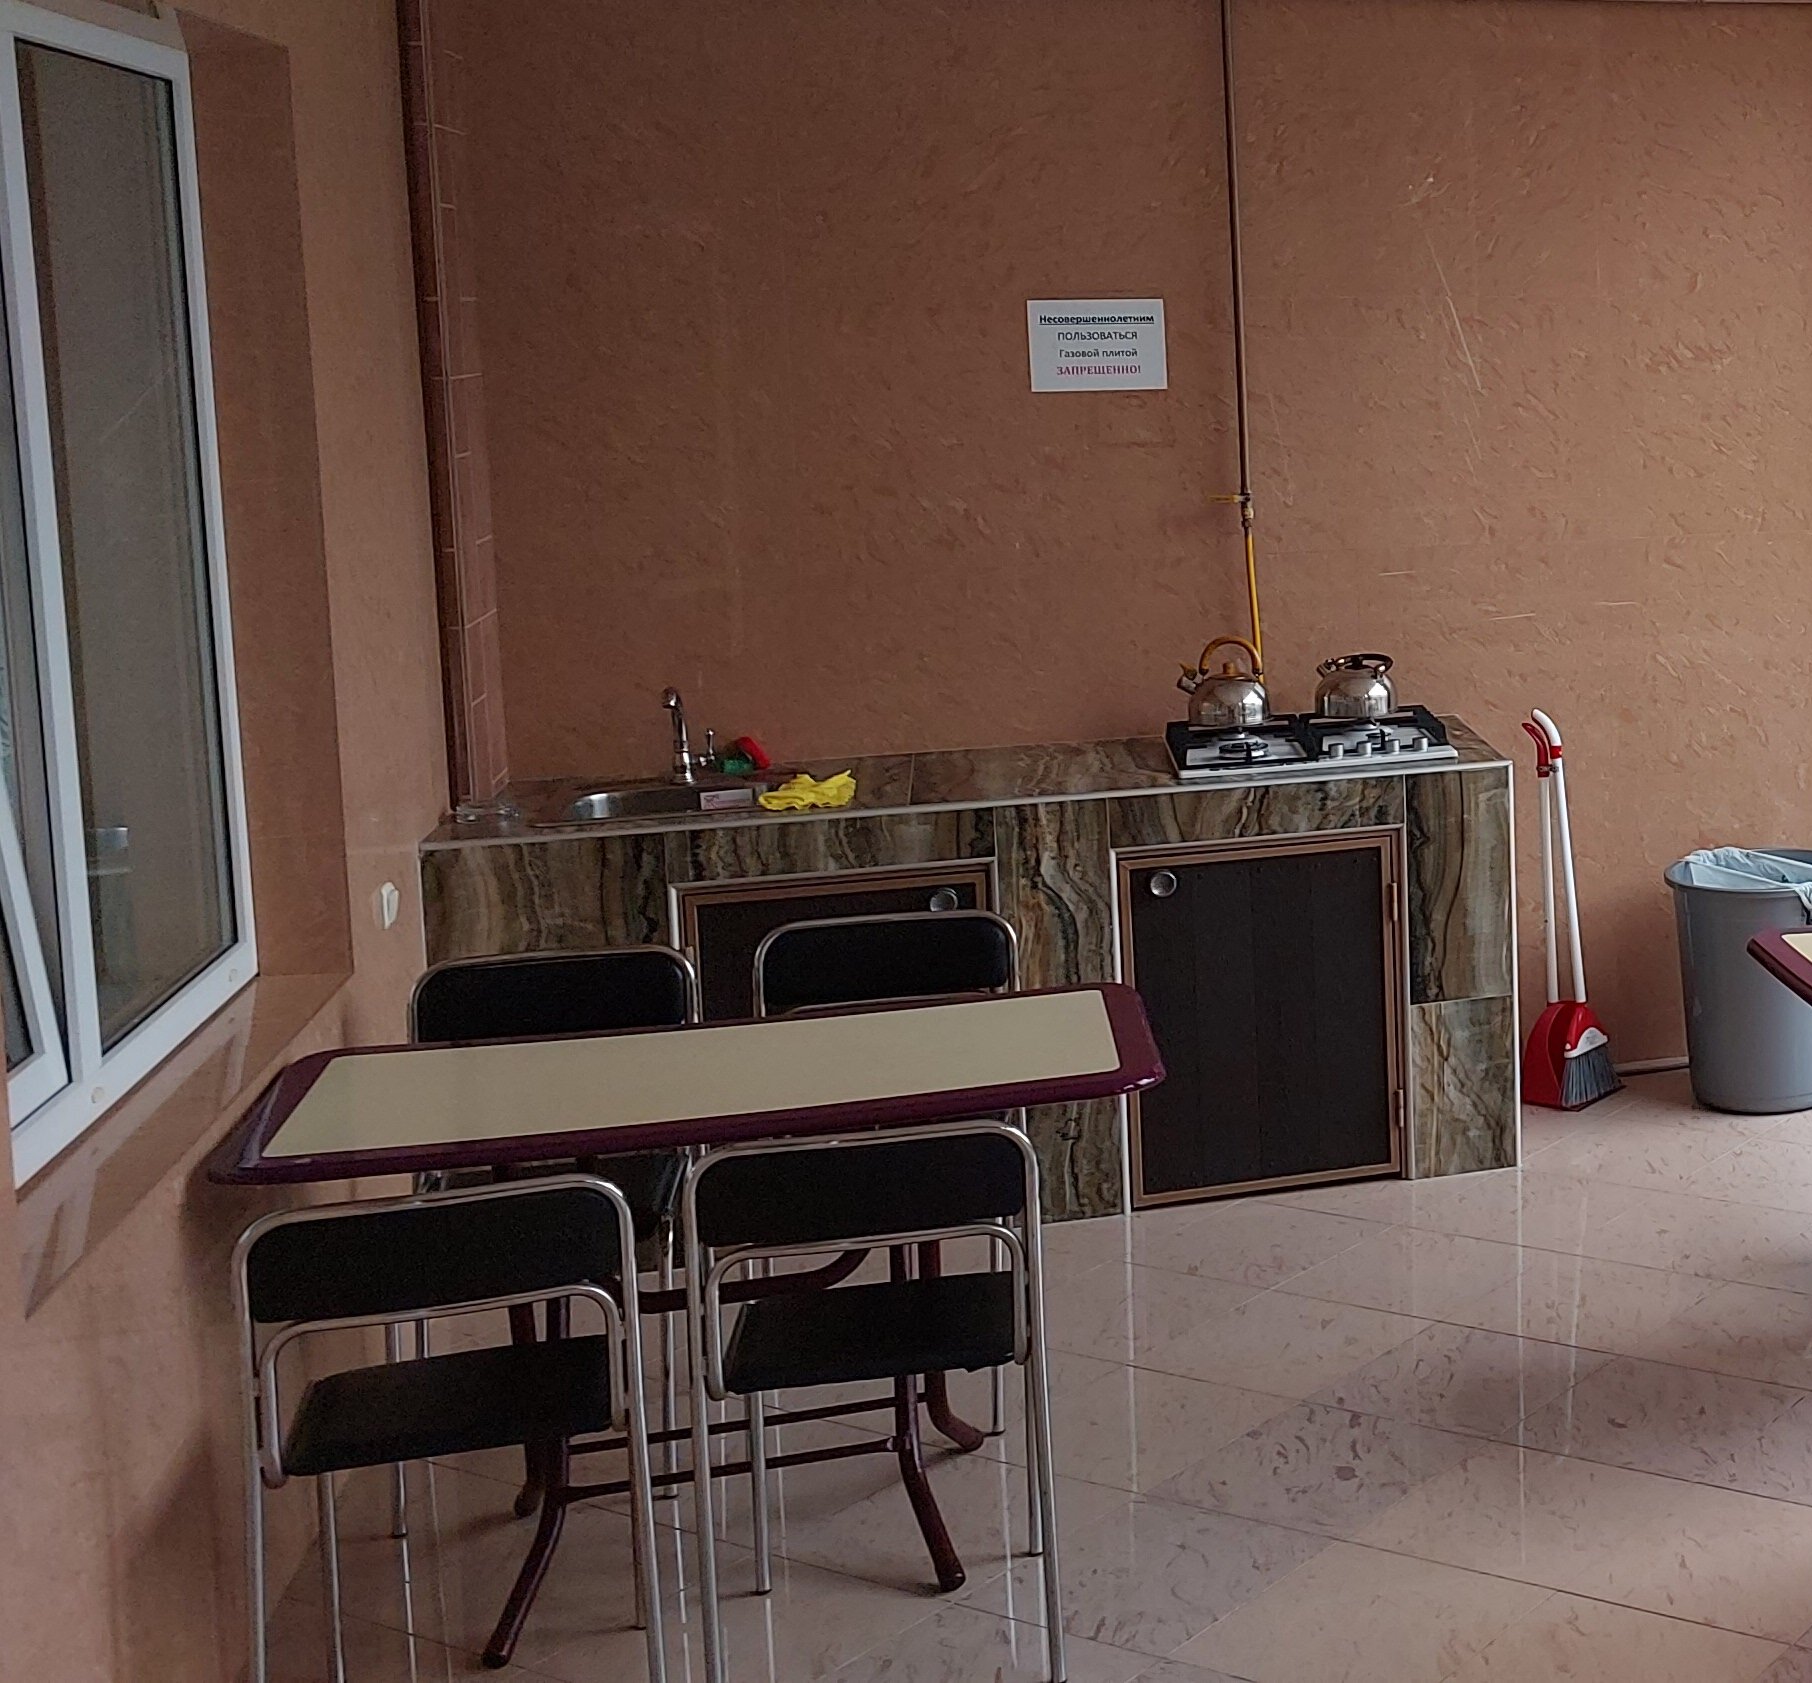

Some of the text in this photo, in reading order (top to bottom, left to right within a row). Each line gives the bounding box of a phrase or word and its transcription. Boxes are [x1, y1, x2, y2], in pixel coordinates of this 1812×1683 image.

[1039, 314, 1155, 325] Несовершеннолетним
[1057, 331, 1138, 341] ПОЛЬЗОВАТЬСЯ
[1059, 348, 1138, 358] Газовой плитой
[1056, 365, 1141, 376] ЗАПРЕЩЕННО!
